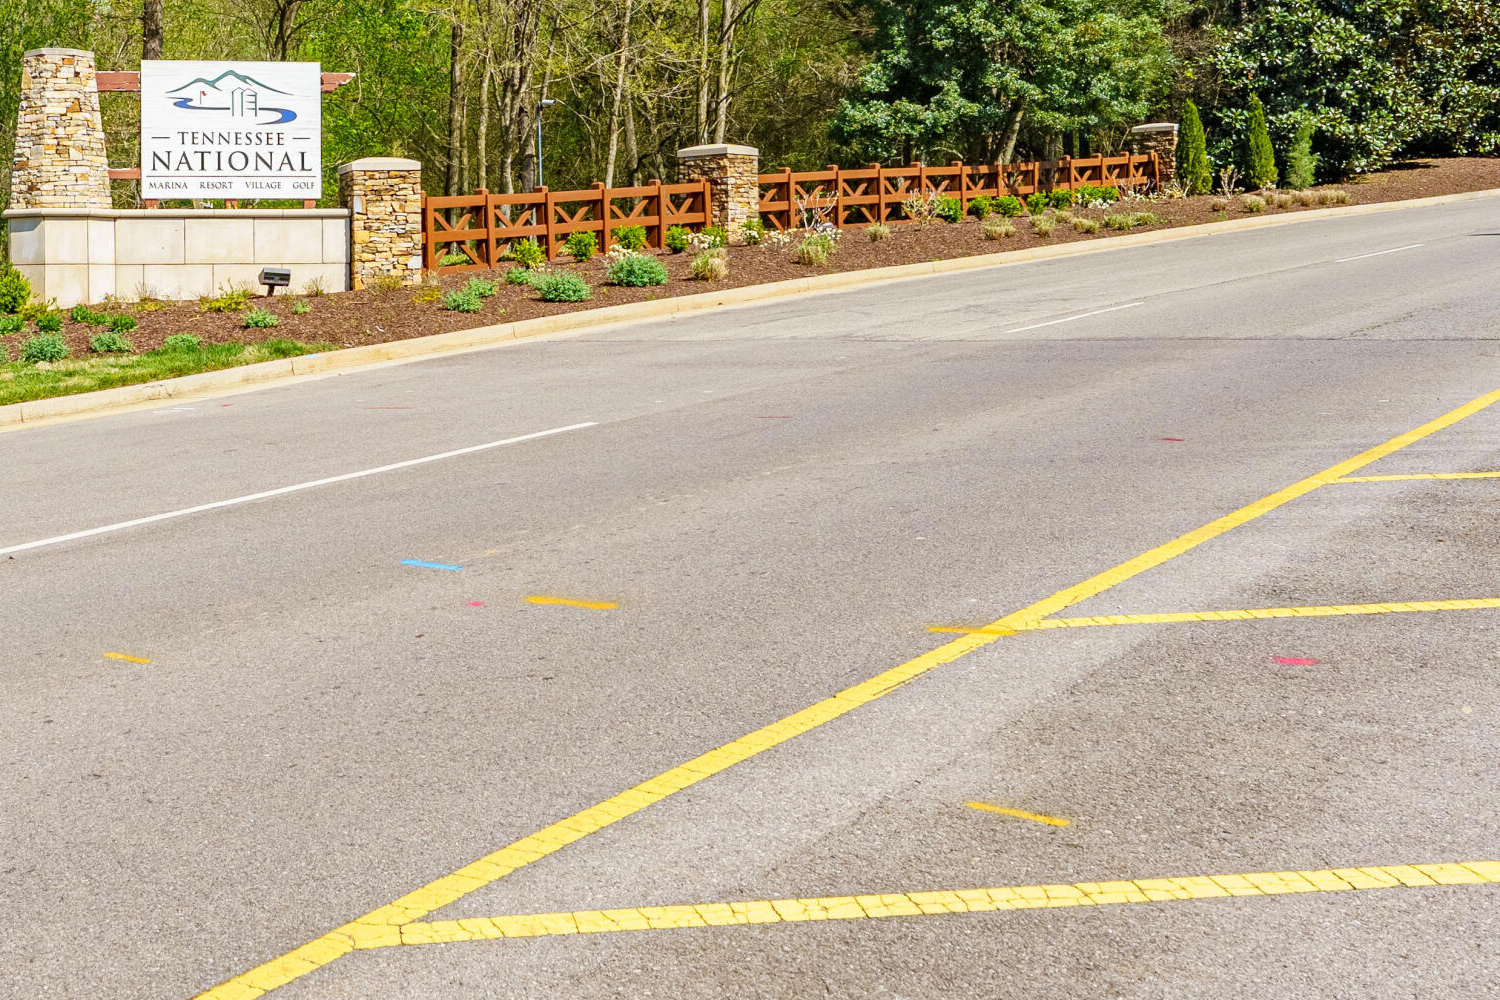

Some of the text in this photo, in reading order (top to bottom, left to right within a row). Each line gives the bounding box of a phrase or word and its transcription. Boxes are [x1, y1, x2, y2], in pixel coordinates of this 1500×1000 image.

[177, 131, 285, 146] TENNESSEE
[151, 150, 313, 172] NATIONAL
[148, 181, 316, 190] MARINA RESORT VILLAGE GOLF
